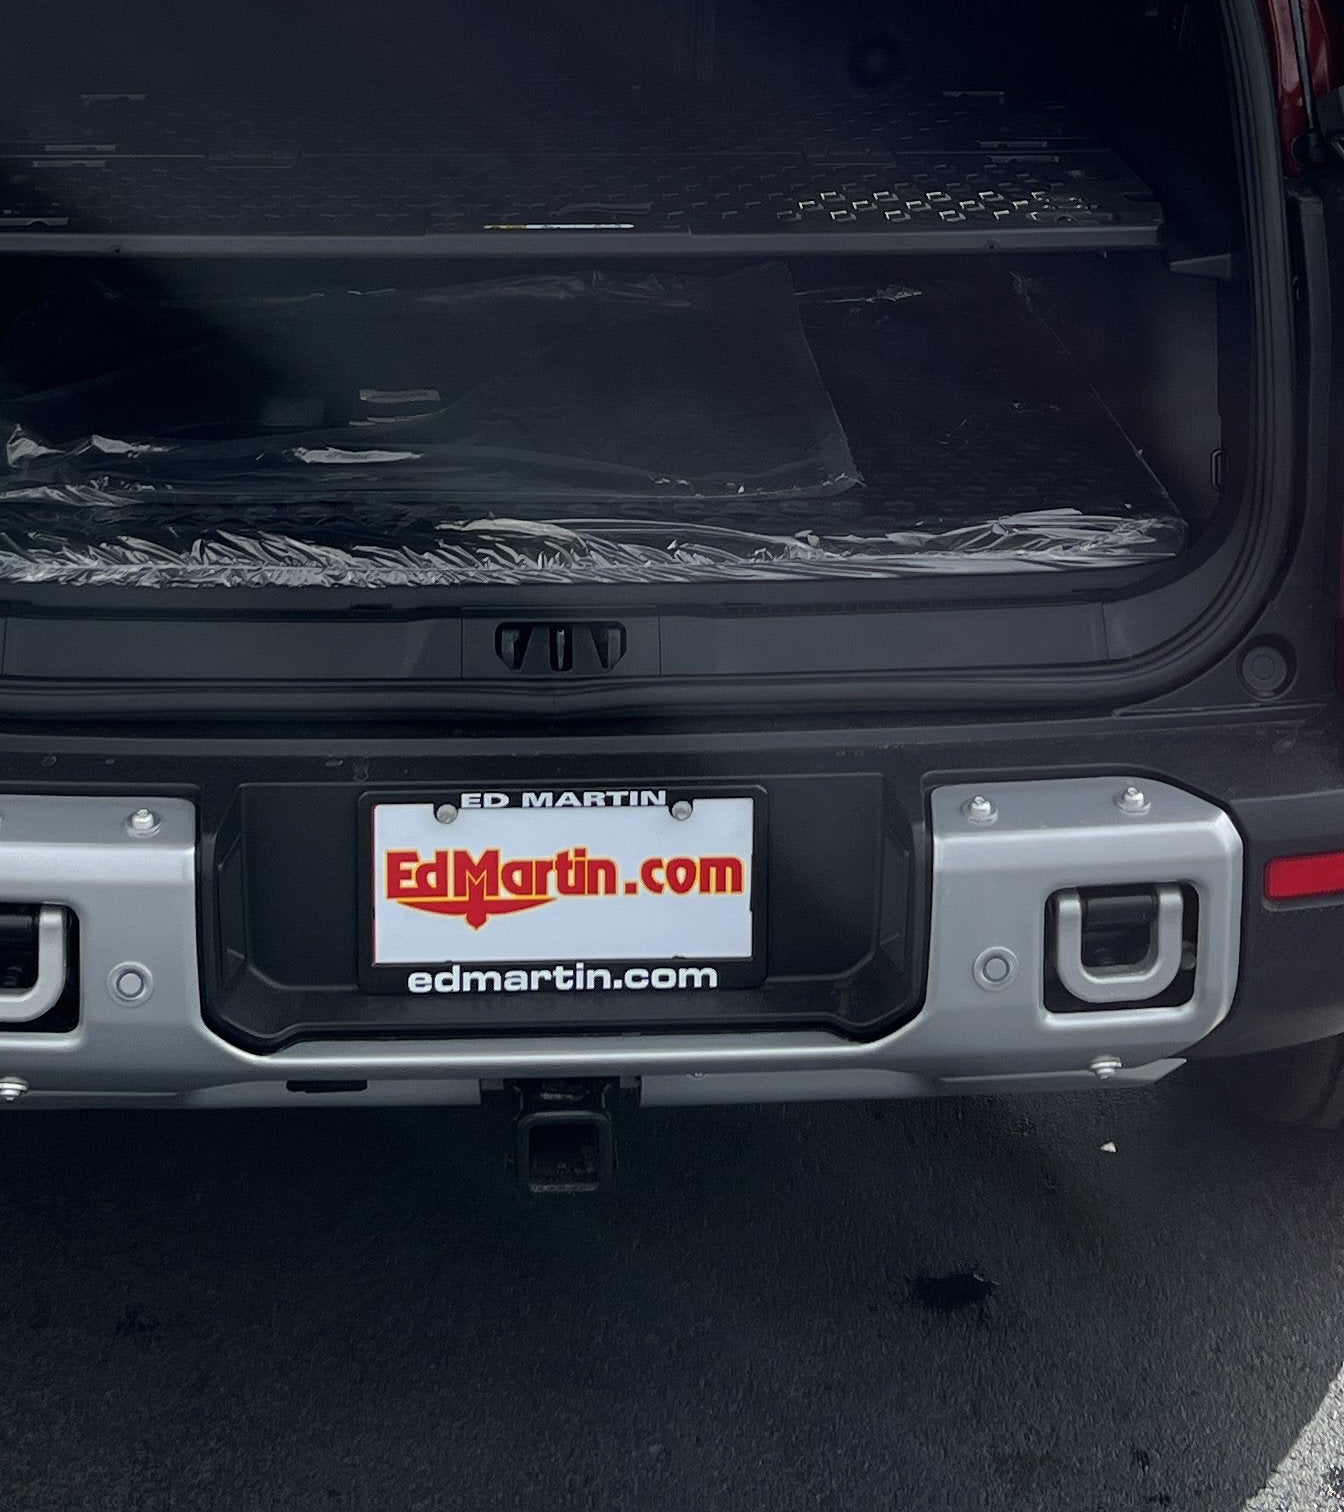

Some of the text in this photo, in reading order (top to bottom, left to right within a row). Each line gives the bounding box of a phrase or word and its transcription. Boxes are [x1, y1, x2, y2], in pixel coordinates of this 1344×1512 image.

[460, 790, 667, 809] ED MARTIN
[384, 846, 745, 901] EdMartin.com
[407, 962, 719, 994] edmartin.com
